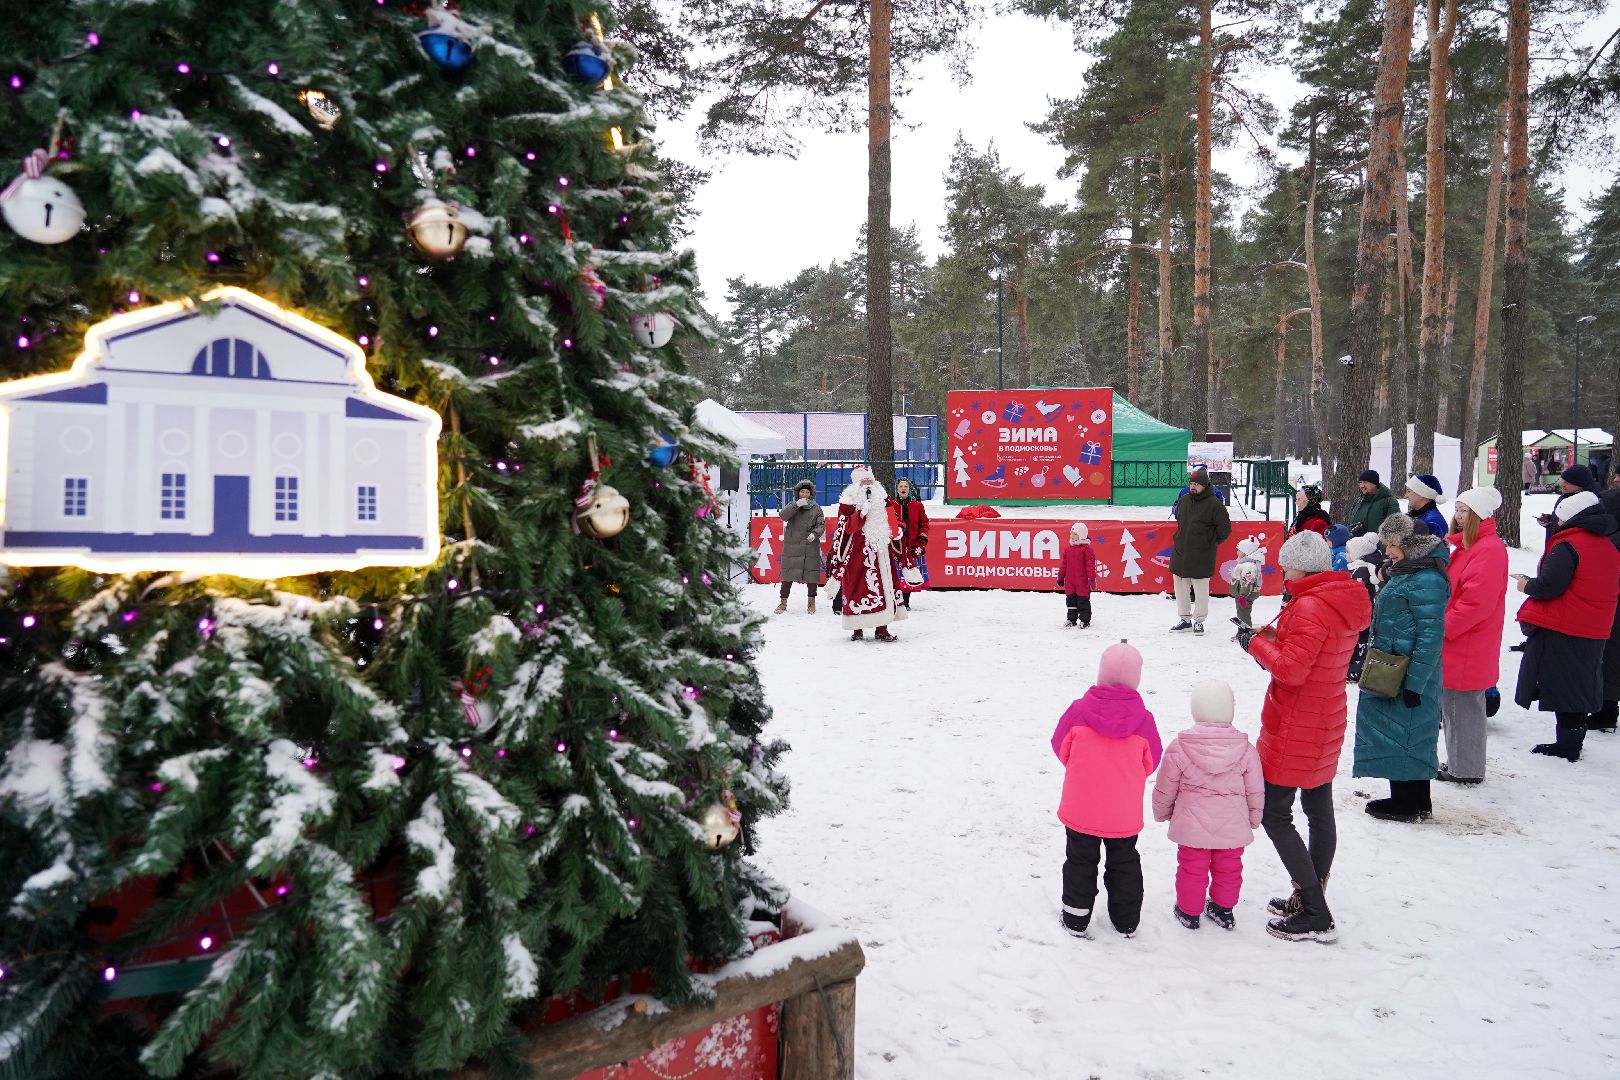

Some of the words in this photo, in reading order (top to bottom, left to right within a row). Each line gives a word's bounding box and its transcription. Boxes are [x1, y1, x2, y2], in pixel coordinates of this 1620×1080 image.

[998, 427, 1058, 443] ЗИМА
[945, 529, 1060, 560] ЗИМА
[945, 564, 954, 575] В
[957, 565, 1059, 578] ПОДМОСКОВЬЕ
